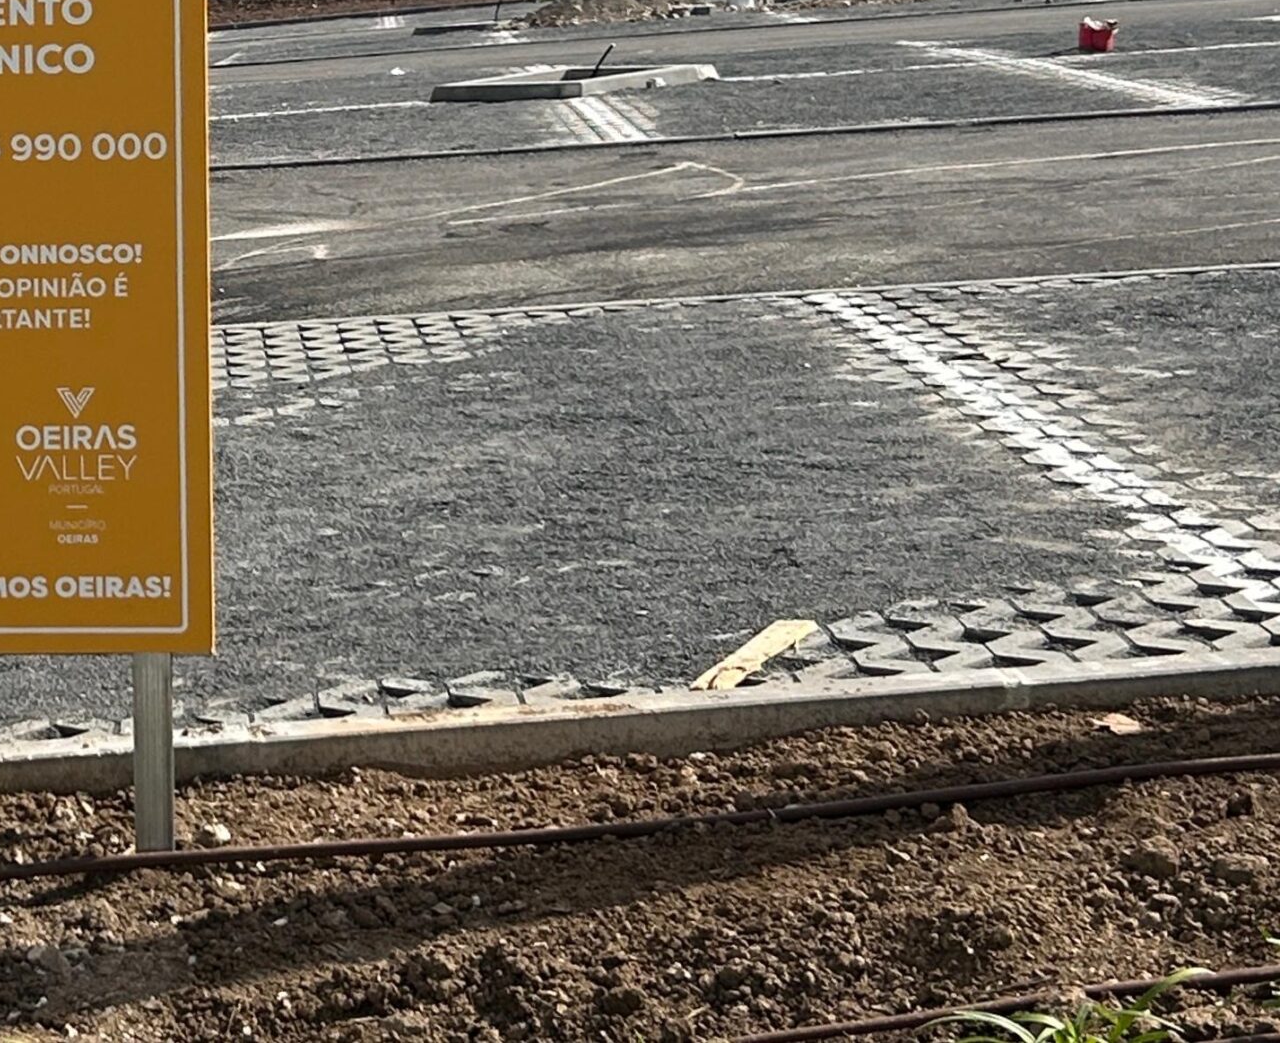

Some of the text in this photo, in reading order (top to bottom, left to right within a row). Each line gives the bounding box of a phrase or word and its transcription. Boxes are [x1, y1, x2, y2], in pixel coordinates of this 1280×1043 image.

[11, 134, 81, 161] 990
[92, 133, 167, 160] 000
[115, 273, 127, 296] É
[16, 425, 136, 450] OEIRAS
[16, 455, 136, 480] VALLEY
[49, 484, 103, 493] PORTUGAL
[58, 535, 98, 543] OEIRAS
[55, 577, 170, 597] OEIRAS!
